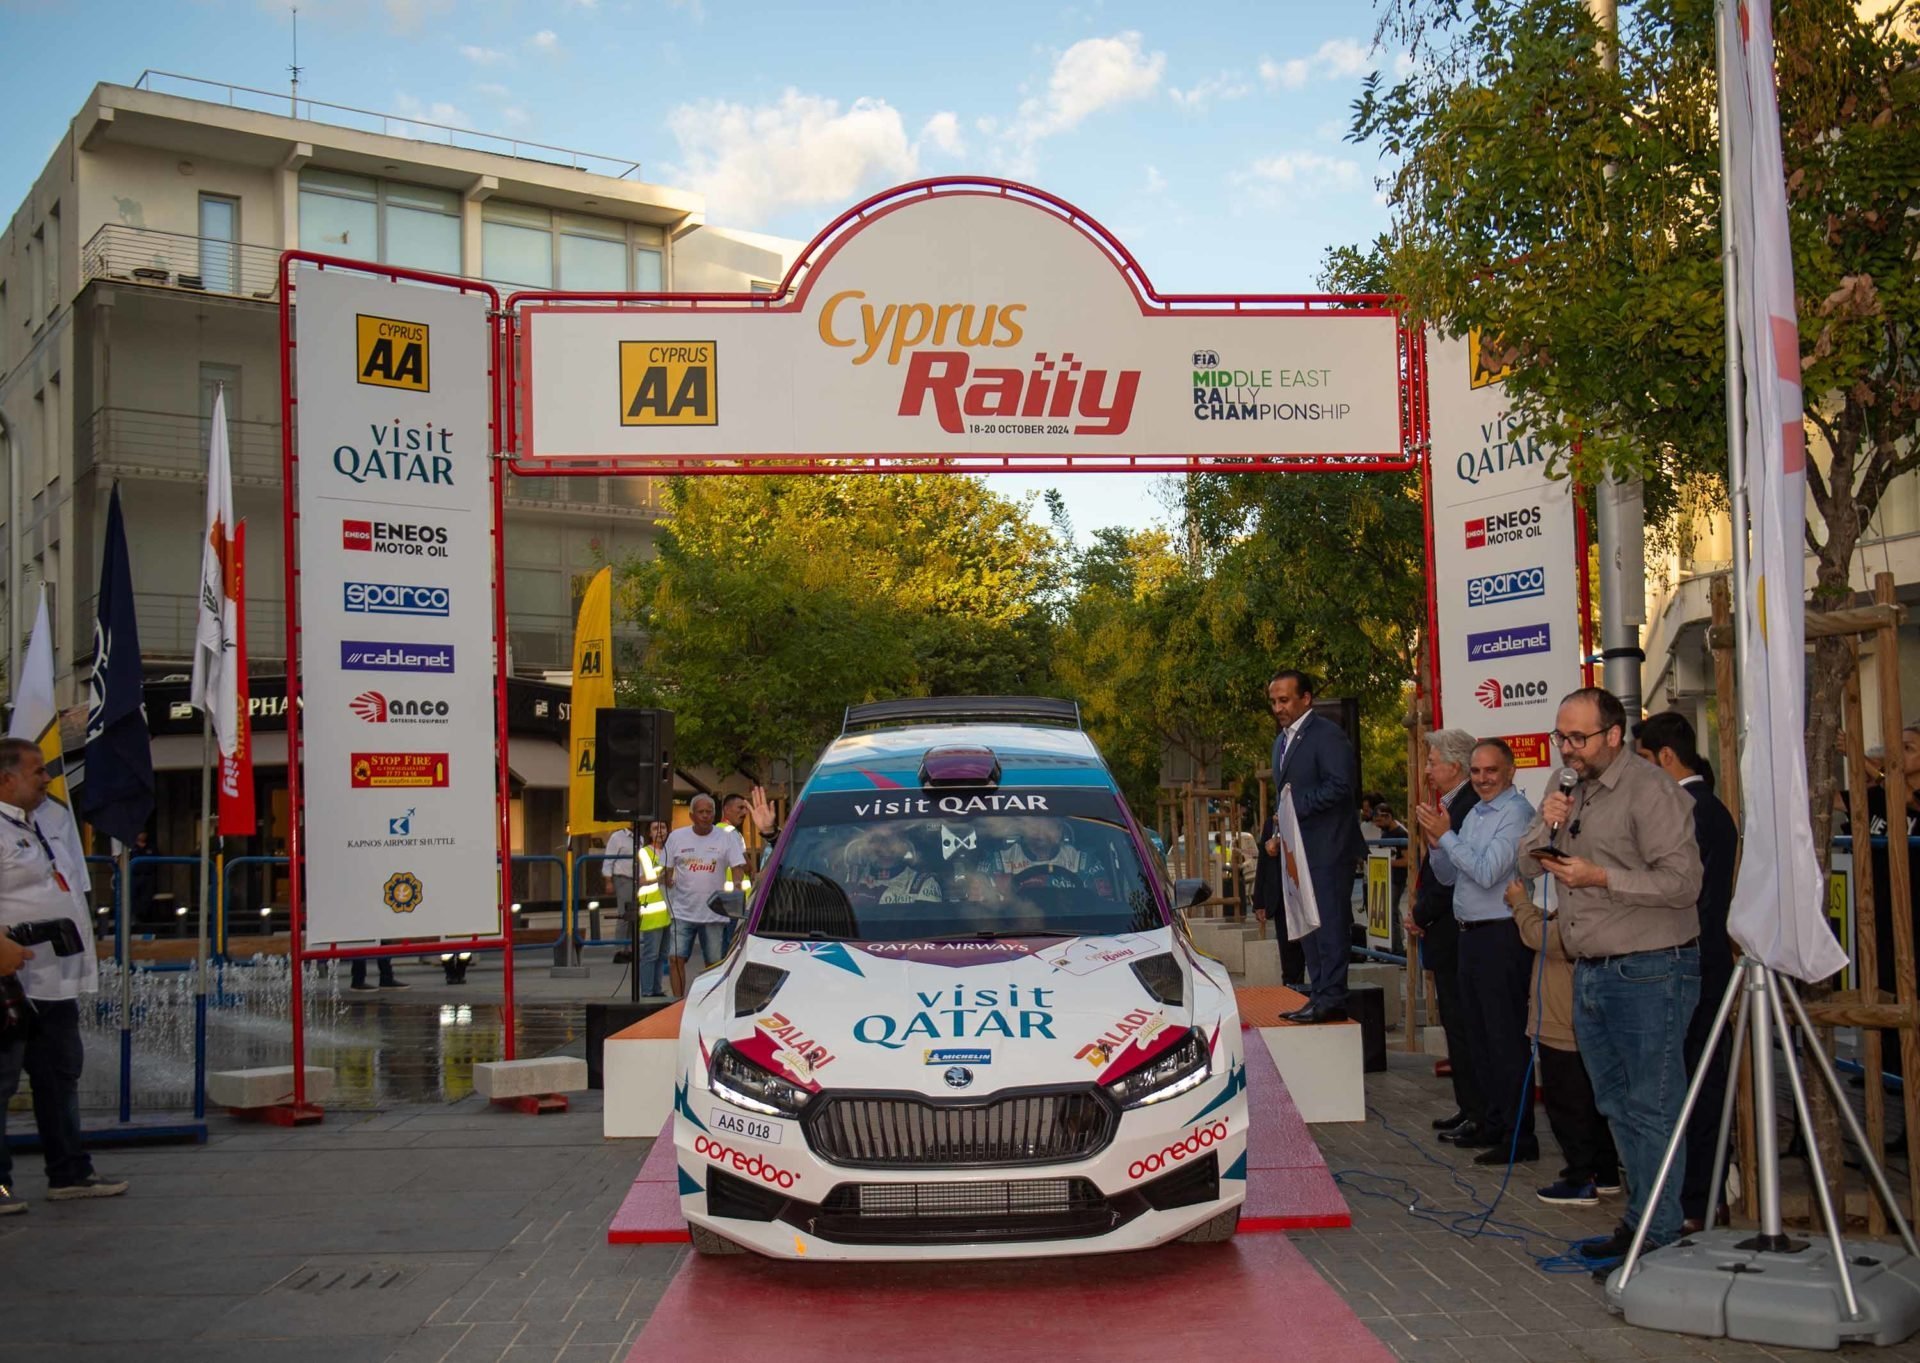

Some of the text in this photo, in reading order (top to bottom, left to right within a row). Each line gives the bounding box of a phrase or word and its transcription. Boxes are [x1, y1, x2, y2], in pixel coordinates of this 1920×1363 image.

[378, 322, 423, 341] CYPRUS
[818, 290, 1027, 365] Cyprus
[362, 338, 423, 384] AA
[650, 347, 708, 363] CYPRUS
[1193, 370, 1331, 387] MIDDLE EAST
[627, 366, 708, 417] AA
[897, 351, 1142, 436] Rally
[1193, 387, 1260, 404] RALLY
[1194, 403, 1351, 420] CHAMPIONSHIP
[370, 418, 453, 454] visit
[969, 424, 1069, 434] 18-20 OCTOBER 2024
[333, 445, 454, 485] QATAR
[1486, 506, 1541, 533] ENEOS
[344, 531, 371, 540] ENEOS
[373, 522, 448, 544] ENEOS
[1487, 526, 1542, 546] MOTOR OIL
[374, 542, 448, 557] MOTOR OIL
[1469, 569, 1543, 604] sparco
[346, 583, 448, 612] sparco
[1482, 630, 1547, 654] cablenet
[362, 649, 450, 667] cablenet
[1502, 680, 1548, 700] anco
[389, 700, 449, 716] anco
[371, 755, 432, 766] STOP FIRE
[854, 795, 1049, 816] visit QATAR
[347, 837, 456, 848] KAPNOS AIRPORT SHUTTLE
[866, 942, 1029, 953] QATAR AIRWAYS
[916, 984, 1054, 1008] visit
[853, 1010, 1057, 1048] QATAR
[718, 1114, 770, 1139] AAS 018
[1128, 1116, 1230, 1179] ooredoo
[695, 1135, 801, 1188] ooredoo
